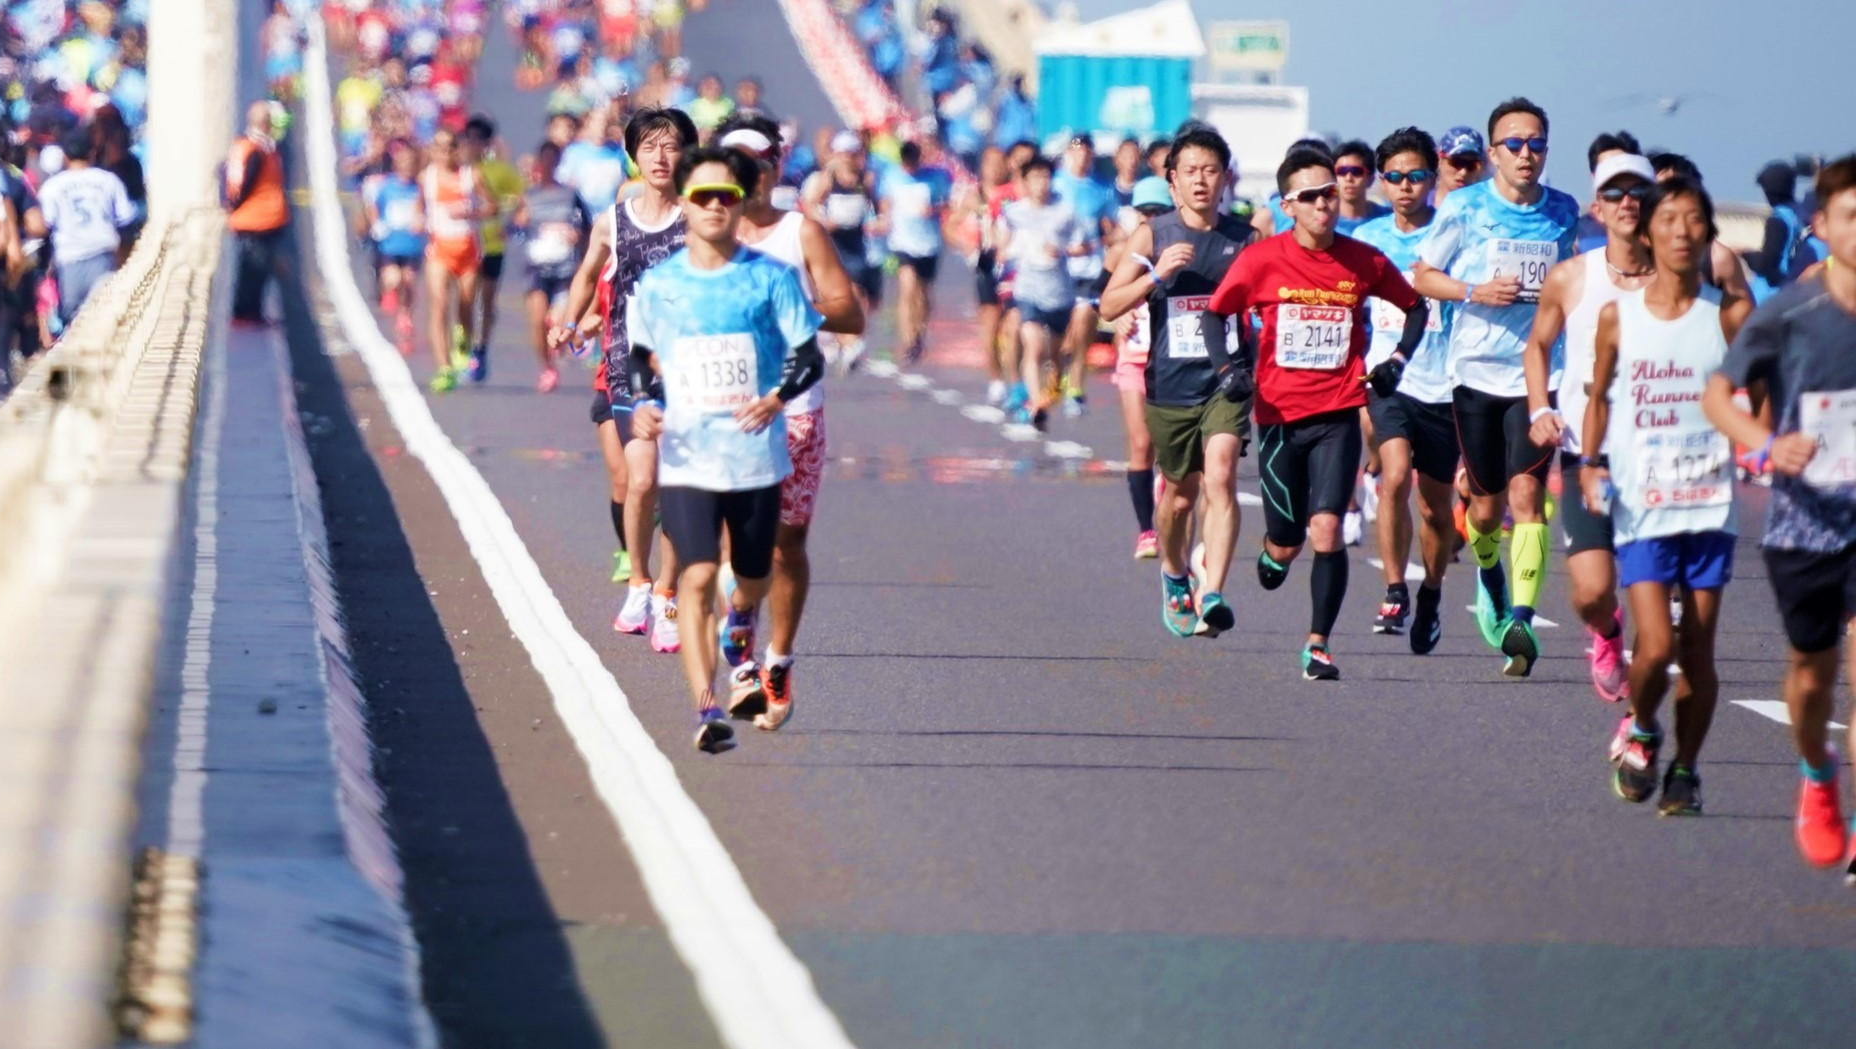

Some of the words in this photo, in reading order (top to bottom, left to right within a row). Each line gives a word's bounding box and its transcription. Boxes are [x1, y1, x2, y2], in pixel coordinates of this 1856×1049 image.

[1305, 325, 1342, 348] 2141
[701, 358, 749, 389] 1338
[1631, 359, 1694, 381] Aloha
[1631, 383, 1701, 405] Runne
[1634, 408, 1680, 428] Club
